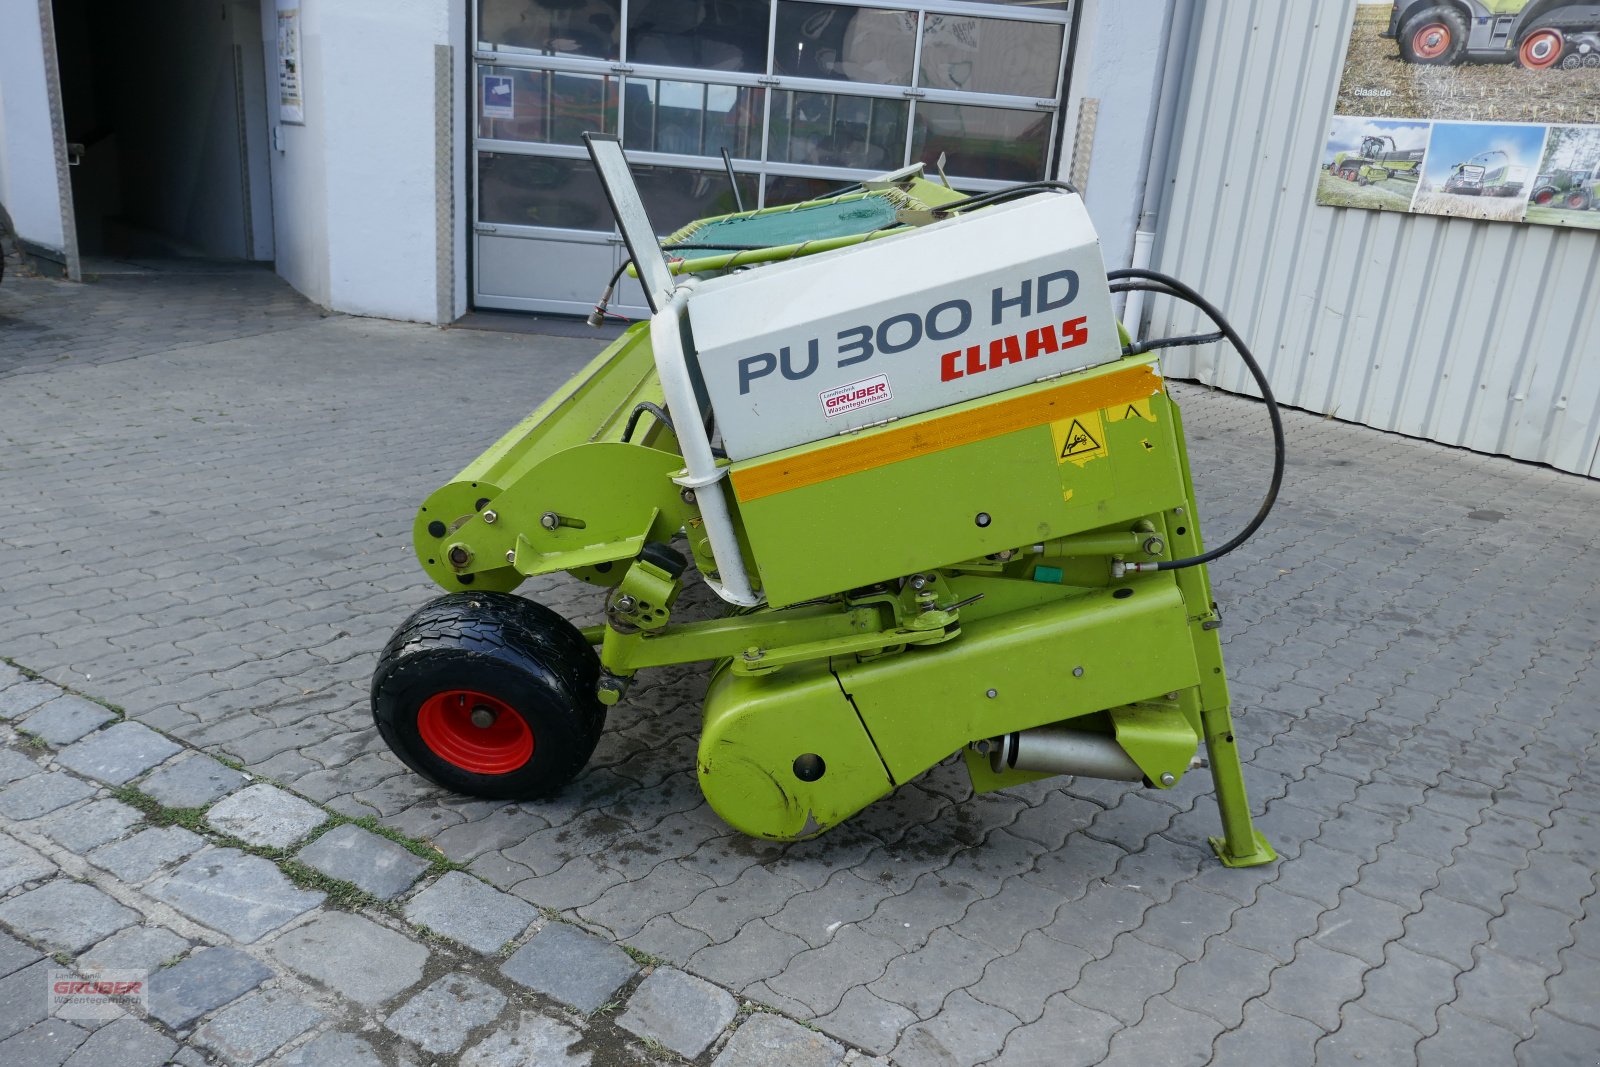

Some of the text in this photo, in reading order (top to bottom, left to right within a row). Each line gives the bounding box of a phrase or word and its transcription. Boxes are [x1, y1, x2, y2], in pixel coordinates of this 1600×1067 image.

[1354, 87, 1392, 97] claas.de
[738, 269, 1080, 395] PU 300 HD
[940, 315, 1088, 382] CLAAS
[823, 385, 855, 399] Landtechnik
[825, 383, 886, 408] GRUBER
[828, 393, 888, 414] Wasentegernbach
